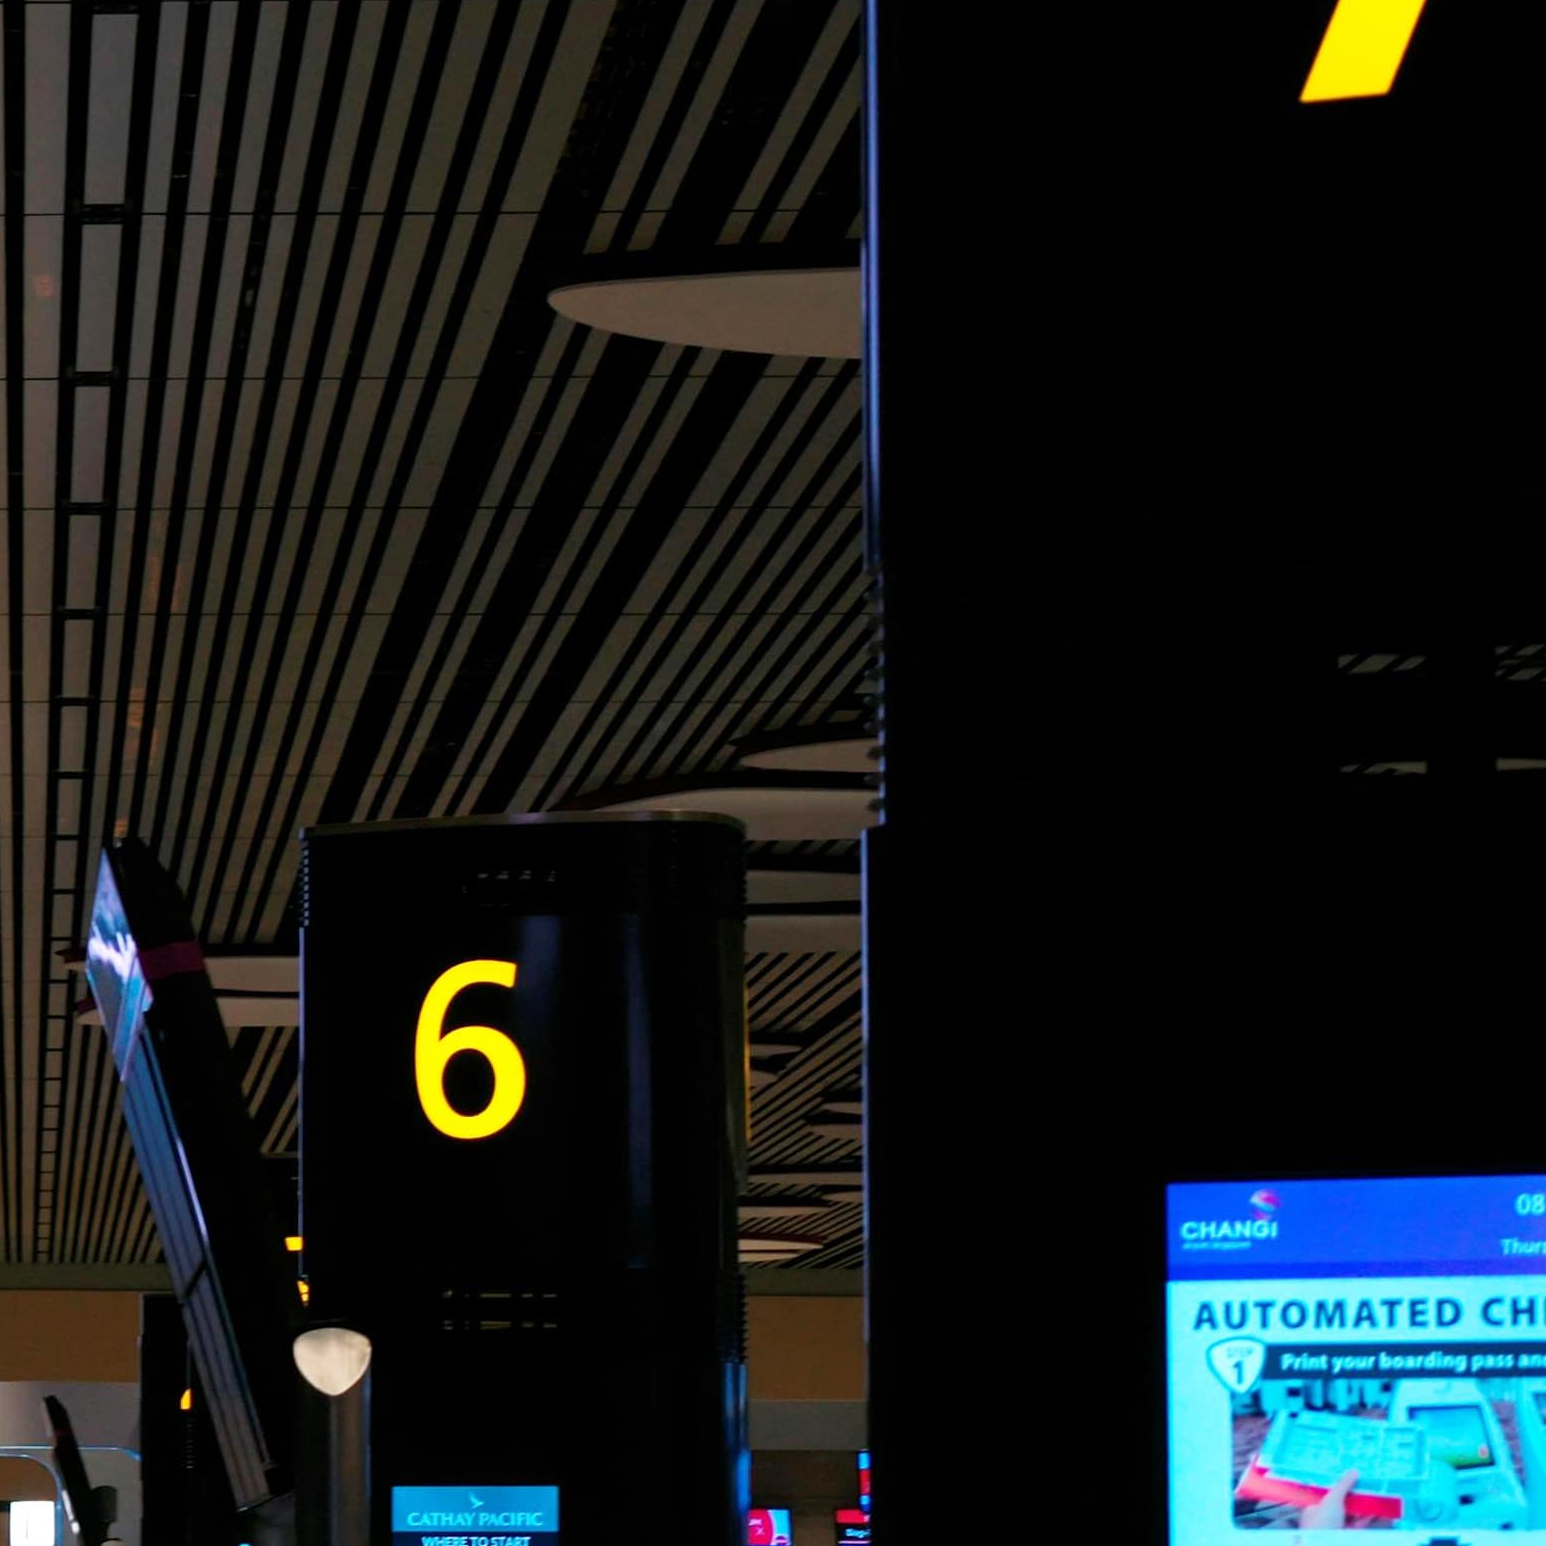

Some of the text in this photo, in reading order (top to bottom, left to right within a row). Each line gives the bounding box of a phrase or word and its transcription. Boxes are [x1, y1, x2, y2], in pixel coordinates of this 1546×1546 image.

[414, 959, 526, 1139] 6
[1180, 1220, 1278, 1240] CHANGI
[1194, 1297, 1462, 1330] AUTOMATED
[1232, 1360, 1244, 1385] 1
[1281, 1352, 1328, 1370] Print
[1332, 1355, 1376, 1374] your
[1379, 1350, 1467, 1373] boarding
[1471, 1353, 1514, 1372] pass
[407, 1512, 544, 1527] CATHAY PACIFIC
